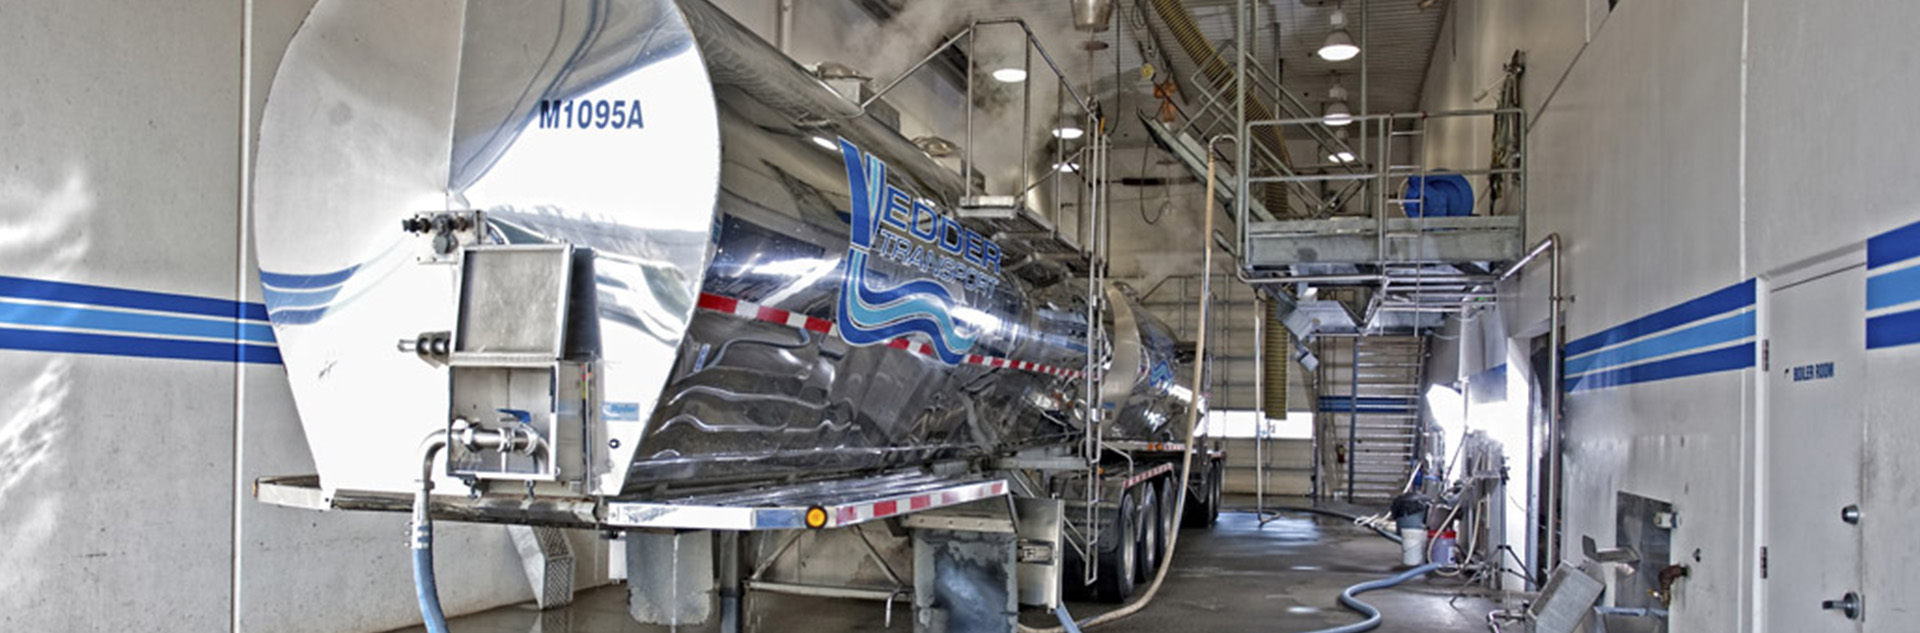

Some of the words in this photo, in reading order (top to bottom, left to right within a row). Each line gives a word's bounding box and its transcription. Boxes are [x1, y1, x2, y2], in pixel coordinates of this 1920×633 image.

[540, 99, 644, 129] M1095A
[837, 136, 1001, 276] VEDDER
[875, 228, 999, 299] TRANSPORT
[1793, 364, 1814, 381] BOILER
[1815, 361, 1834, 379] ROOM
